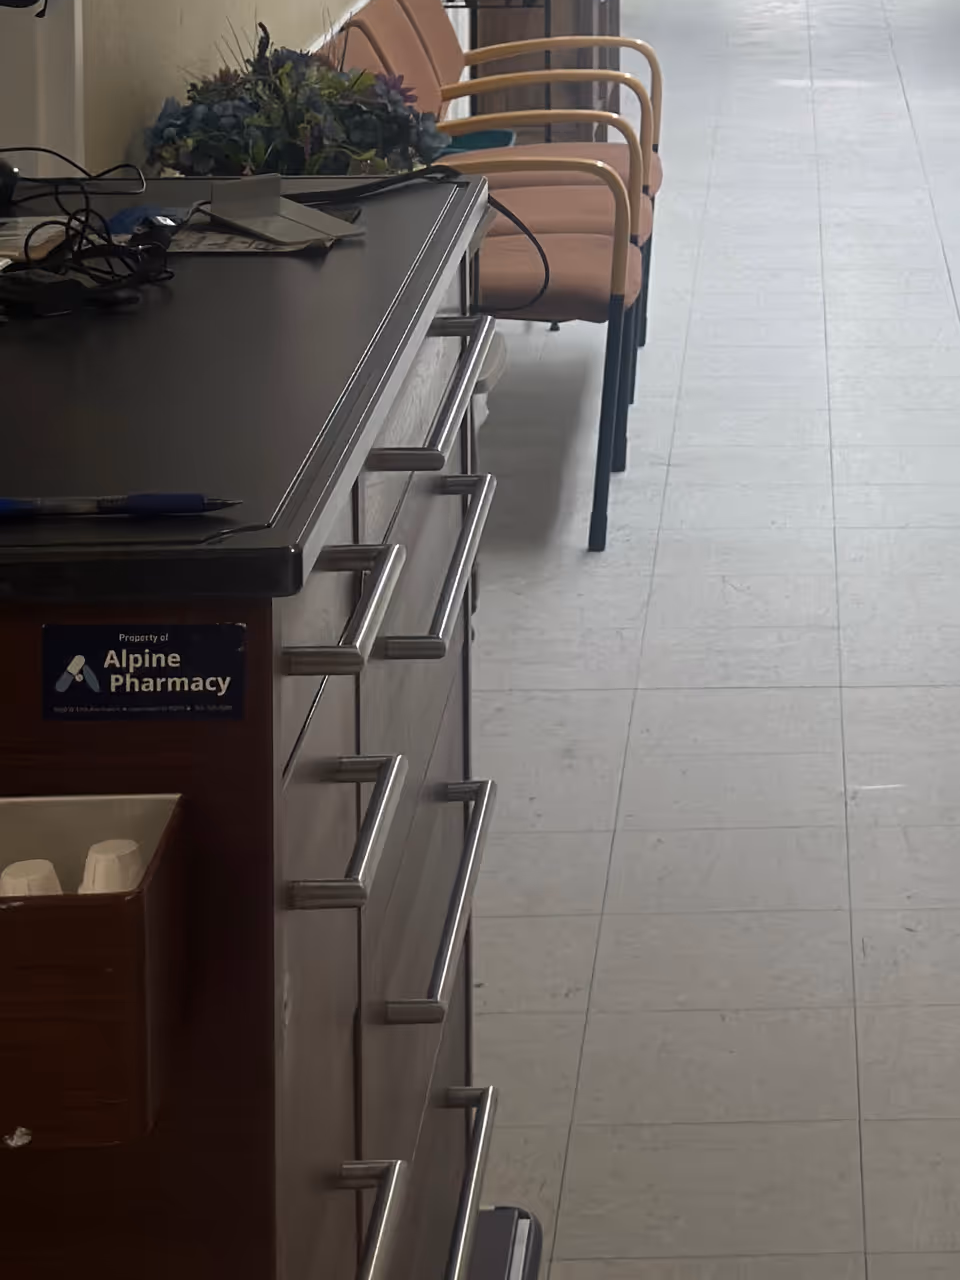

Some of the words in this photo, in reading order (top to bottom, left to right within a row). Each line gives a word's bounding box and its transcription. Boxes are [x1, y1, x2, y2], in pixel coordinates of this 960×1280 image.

[119, 634, 158, 643] Property
[160, 633, 169, 642] of
[103, 649, 181, 673] Alpine
[111, 674, 232, 696] Pharmacy
